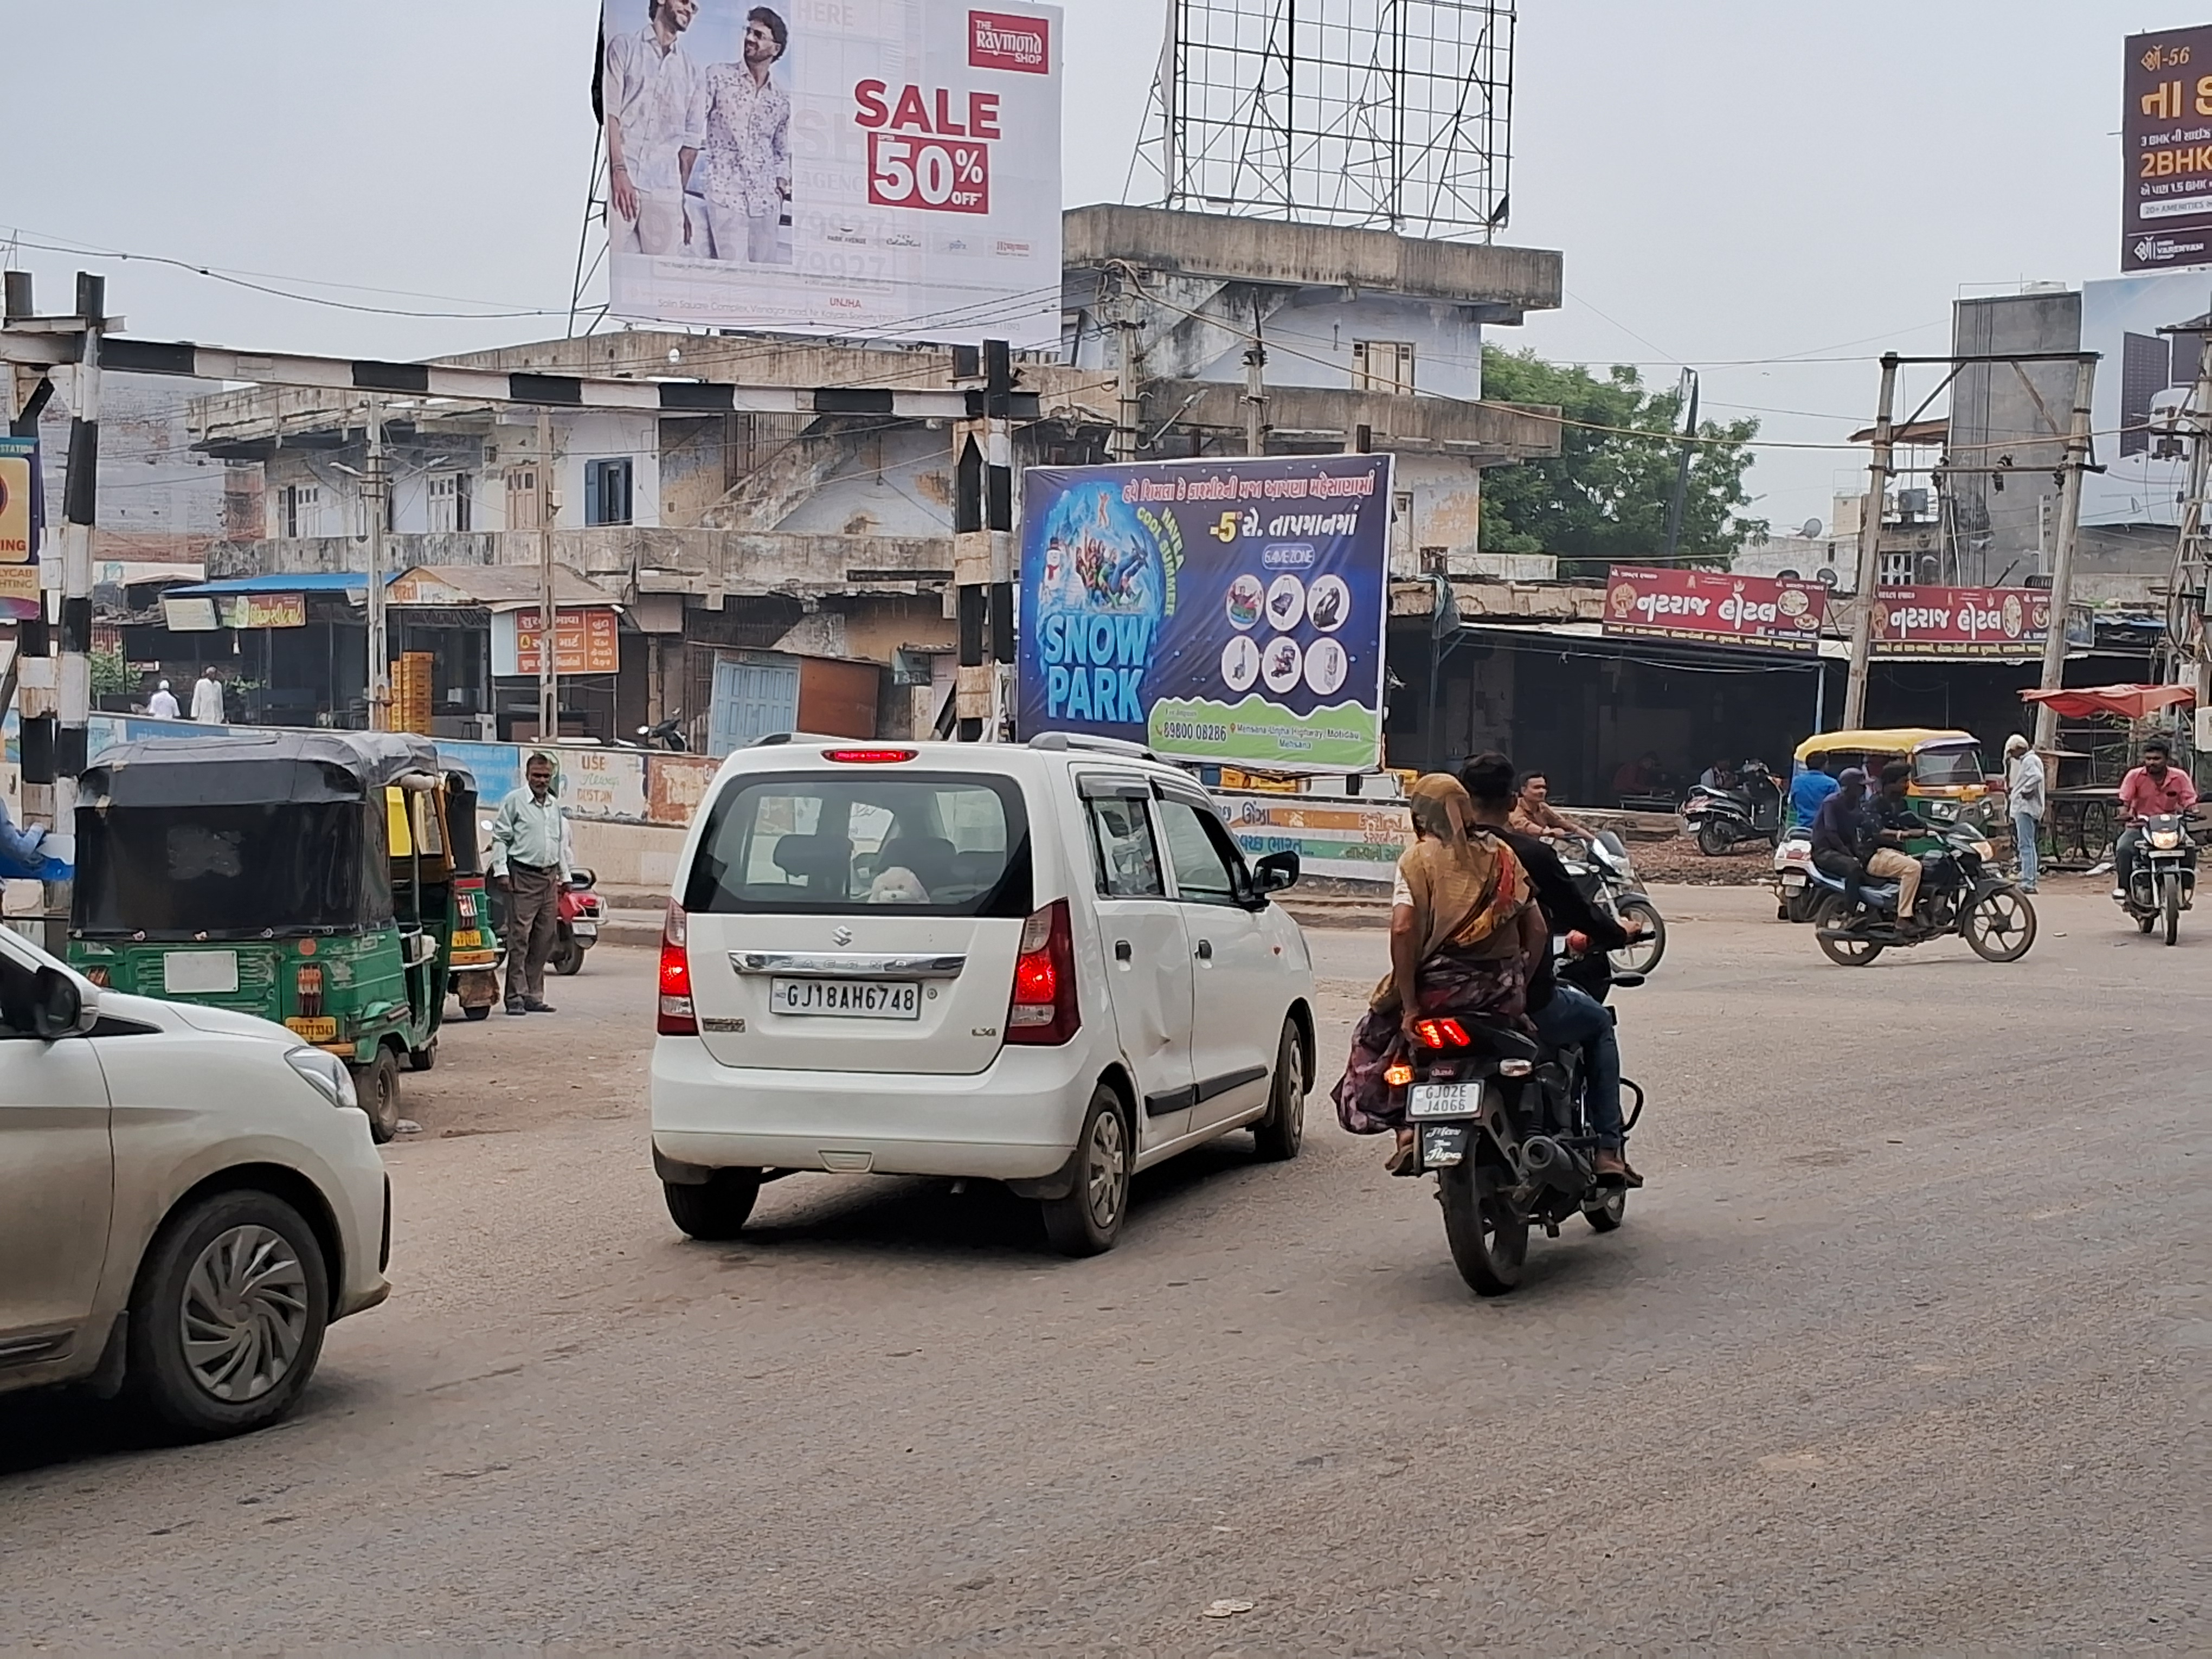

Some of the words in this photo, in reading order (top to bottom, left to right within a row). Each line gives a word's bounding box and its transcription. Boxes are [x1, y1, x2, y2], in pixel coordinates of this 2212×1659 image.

[975, 20, 992, 30] THE
[1014, 53, 1042, 65] SHOP
[854, 79, 1001, 140] SALE
[2140, 145, 2212, 178] 2BHK
[873, 140, 983, 204] 50%
[951, 191, 982, 205] OFF
[829, 297, 862, 308] UNJHA
[1044, 614, 1152, 666] SNOW
[1047, 666, 1145, 723] PARK
[1163, 721, 1193, 740] 89800
[581, 754, 606, 770] USE
[787, 985, 915, 1012] GJ18AH6748
[1426, 1085, 1467, 1099] GJ02E
